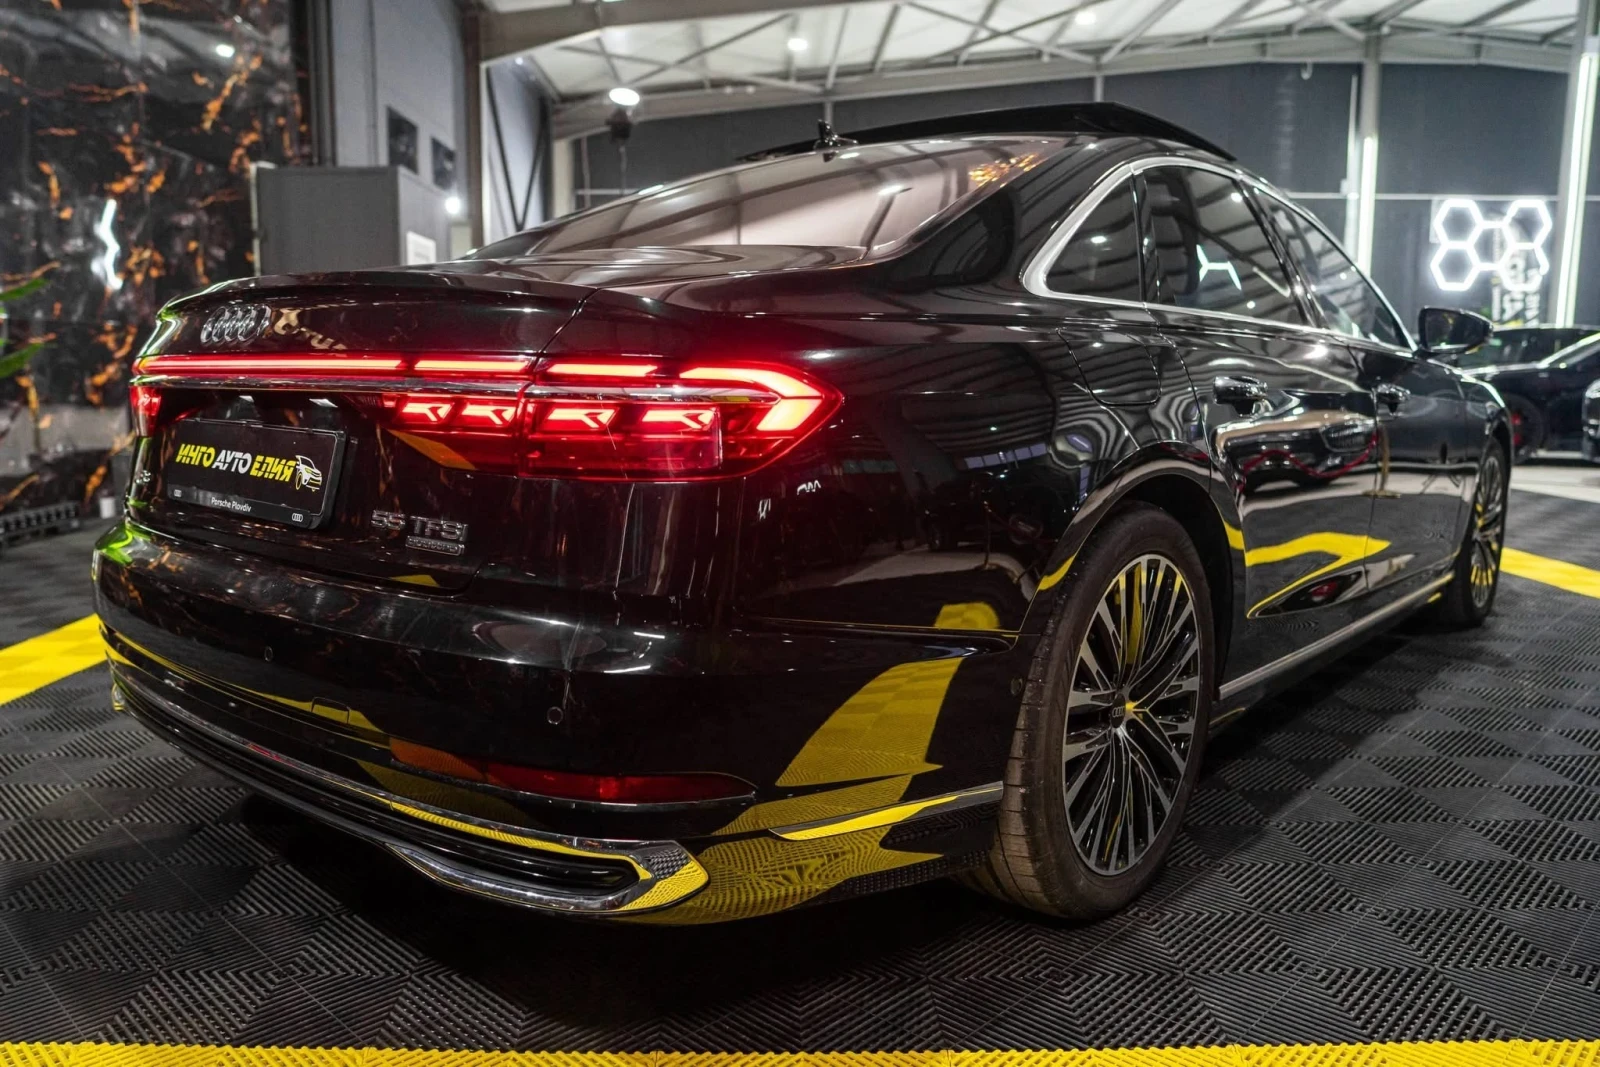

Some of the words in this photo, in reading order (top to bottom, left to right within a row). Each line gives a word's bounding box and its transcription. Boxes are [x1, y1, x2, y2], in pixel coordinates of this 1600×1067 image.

[176, 444, 216, 468] ИНГО
[211, 449, 252, 474] АУТО
[250, 455, 297, 482] ЕЛИЯ
[211, 497, 231, 509] Porsche
[231, 500, 252, 513] Plovdiv
[371, 509, 405, 531] 55
[410, 515, 468, 541] TFSI
